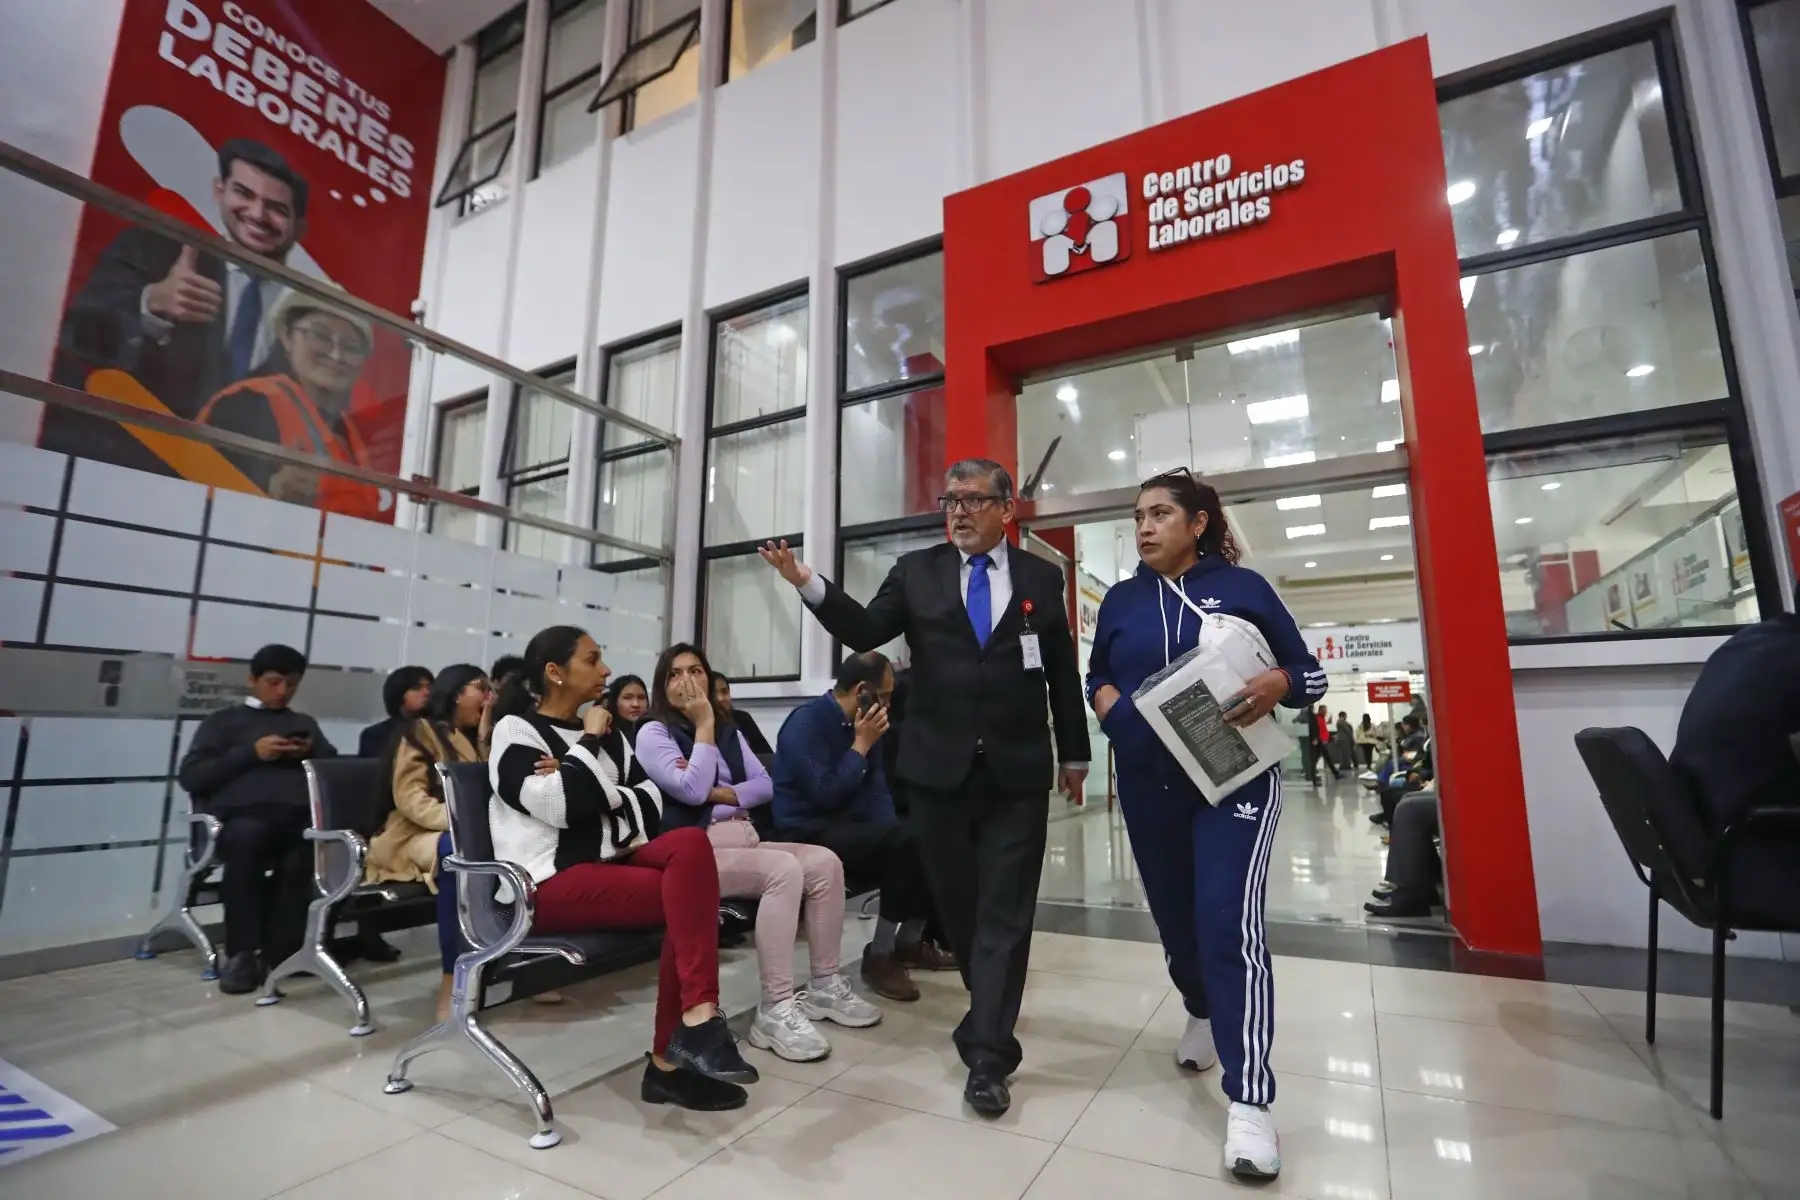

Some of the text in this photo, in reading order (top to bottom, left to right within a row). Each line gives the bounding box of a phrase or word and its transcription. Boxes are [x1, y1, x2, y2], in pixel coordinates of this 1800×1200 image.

[165, 0, 415, 170] DEBERES
[222, 1, 391, 120] CONOCE TUS
[158, 30, 412, 198] LABORALES
[1143, 153, 1231, 199] Centro
[1148, 158, 1305, 223] de Servicios
[1148, 196, 1271, 250] Laborales
[1344, 634, 1370, 642] Centro
[1345, 649, 1384, 658] Laborales
[1356, 640, 1392, 650] Servicios
[1233, 812, 1257, 821] adidas
